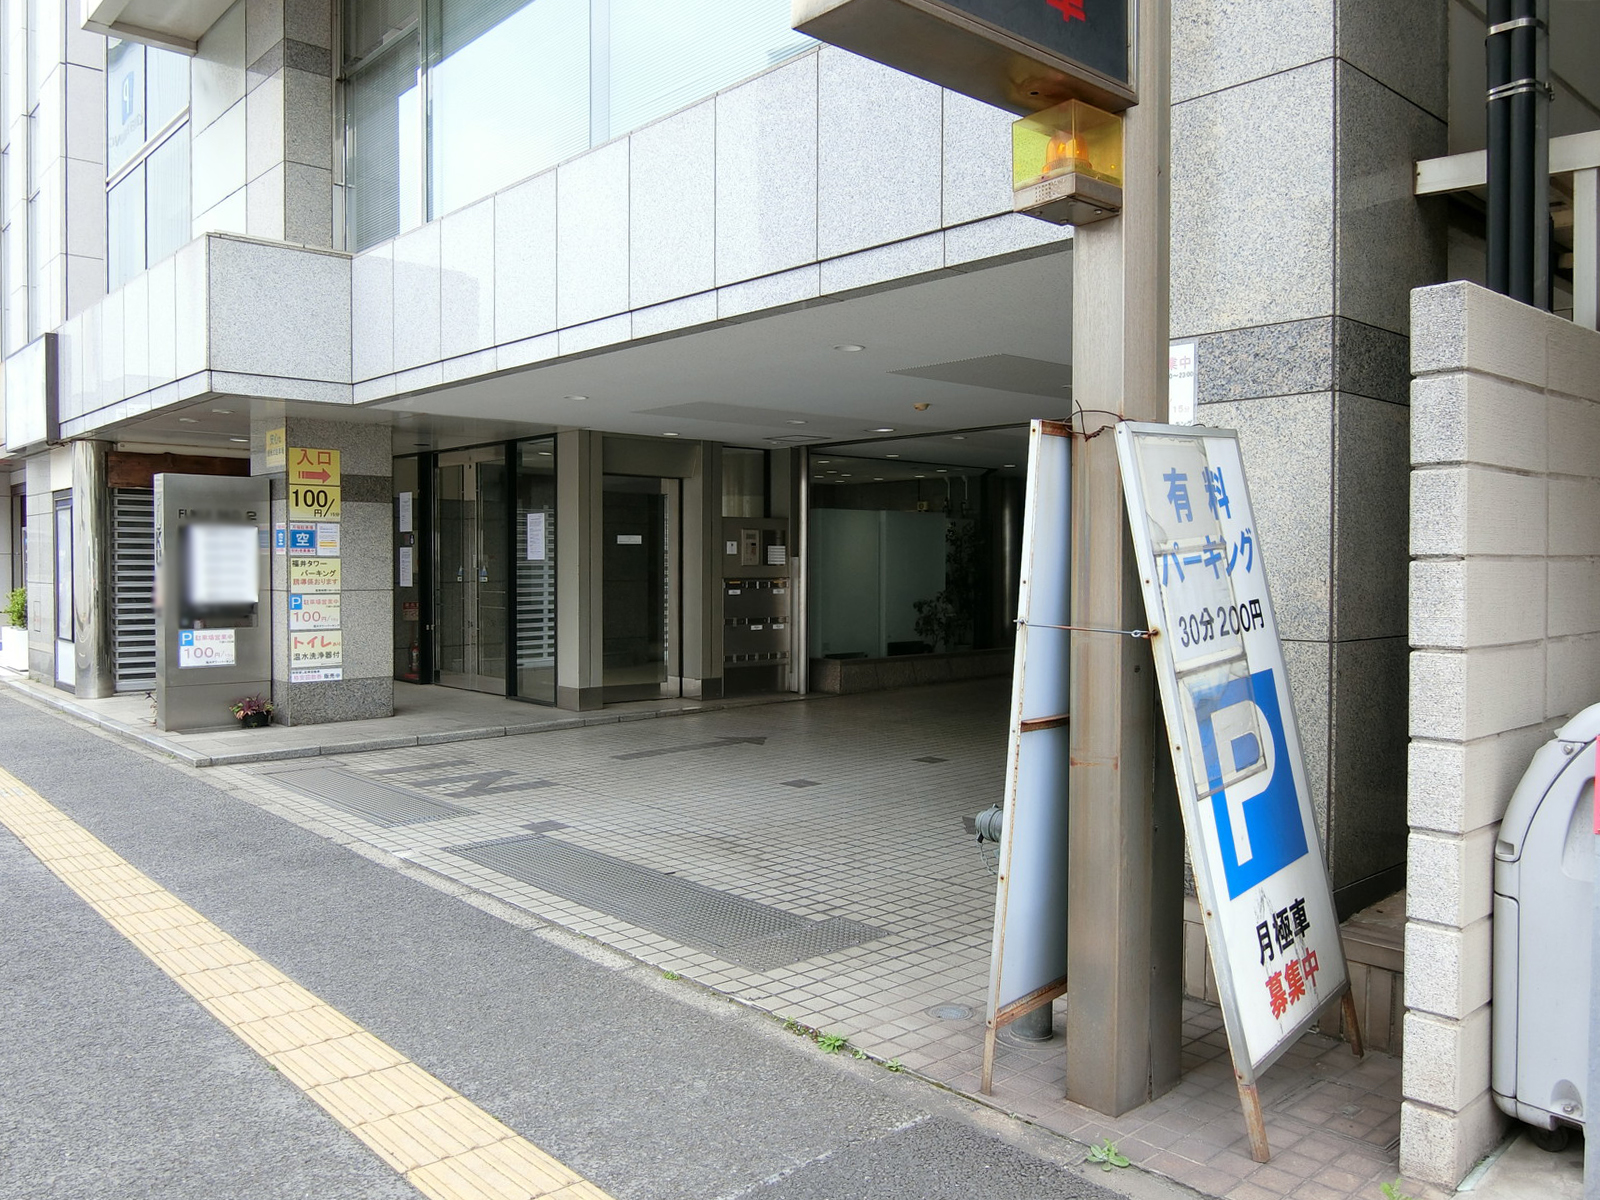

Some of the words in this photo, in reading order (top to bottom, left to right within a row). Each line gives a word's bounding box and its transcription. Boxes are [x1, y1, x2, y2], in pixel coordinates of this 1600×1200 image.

[297, 448, 332, 466] 入口
[292, 488, 328, 507] 100
[1162, 466, 1231, 524] 有料
[296, 532, 310, 546] 空
[1162, 528, 1253, 588] パーキング
[300, 569, 337, 577] パーキング
[291, 596, 301, 609] P
[182, 632, 193, 646] P
[1210, 699, 1276, 867] P
[1256, 897, 1311, 966] 月極車
[1265, 946, 1321, 1020] 募集中
